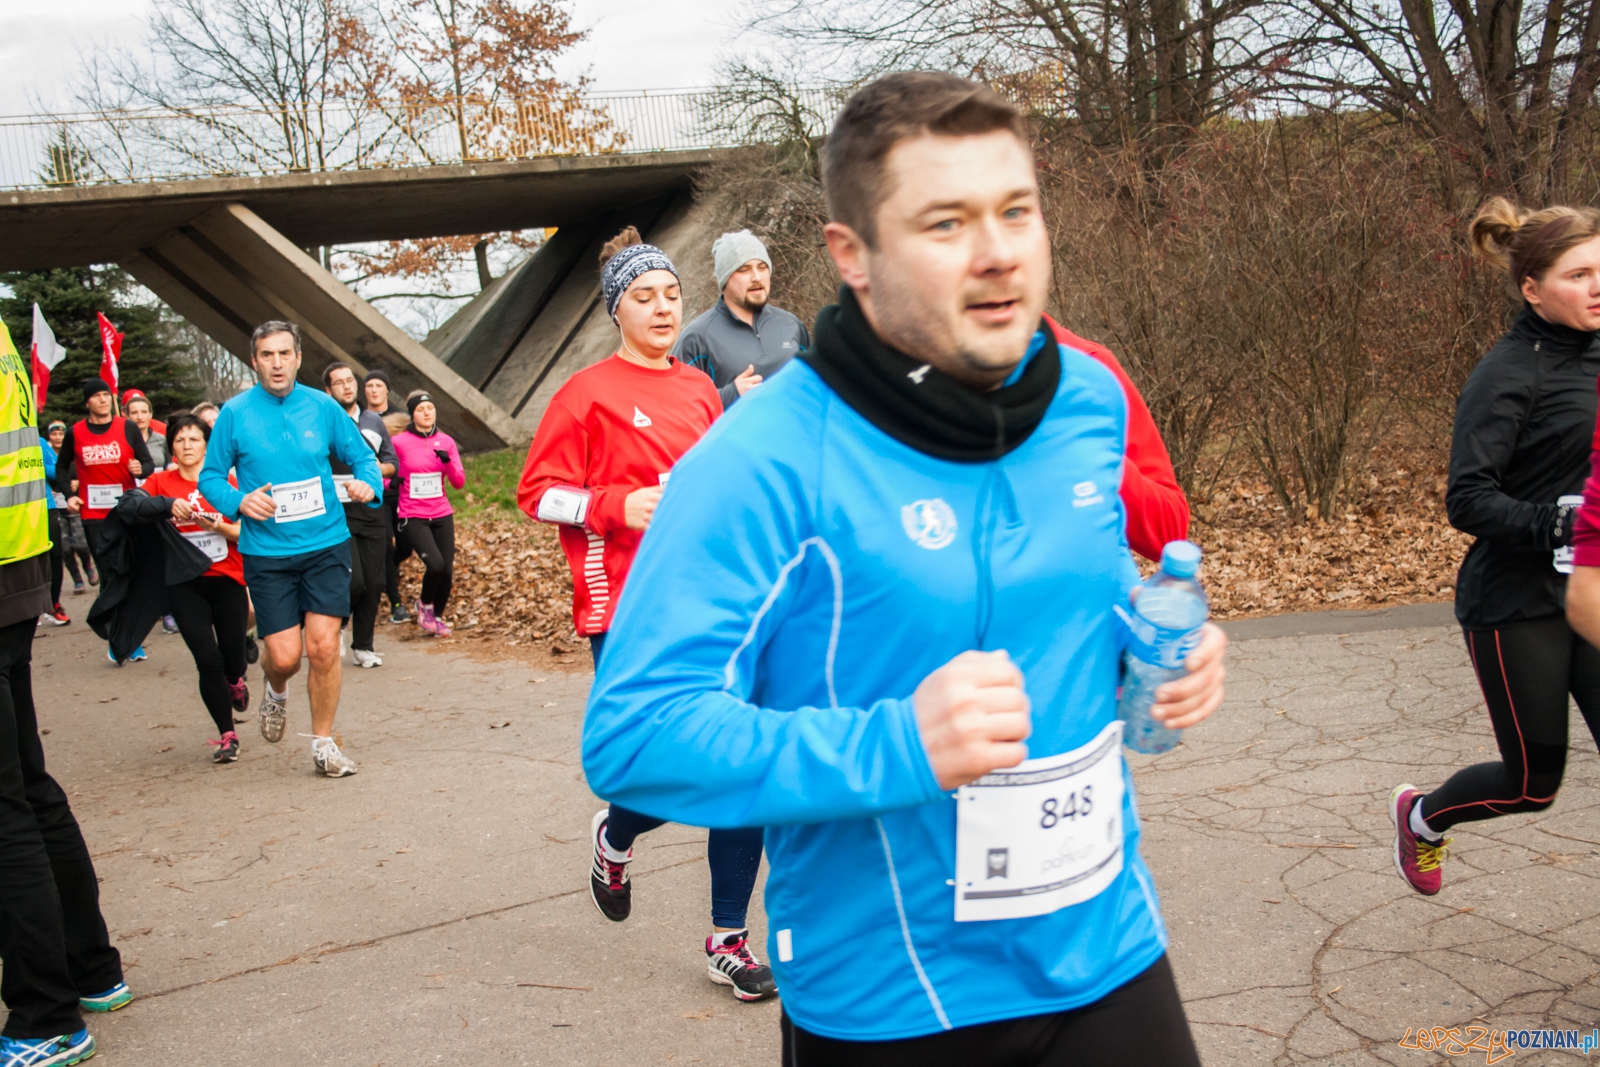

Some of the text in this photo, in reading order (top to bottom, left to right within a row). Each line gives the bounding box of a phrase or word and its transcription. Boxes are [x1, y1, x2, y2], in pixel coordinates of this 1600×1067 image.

[82, 447, 121, 461] SZPIKU
[291, 491, 308, 501] 737
[197, 539, 212, 548] 339
[1040, 785, 1093, 829] 848
